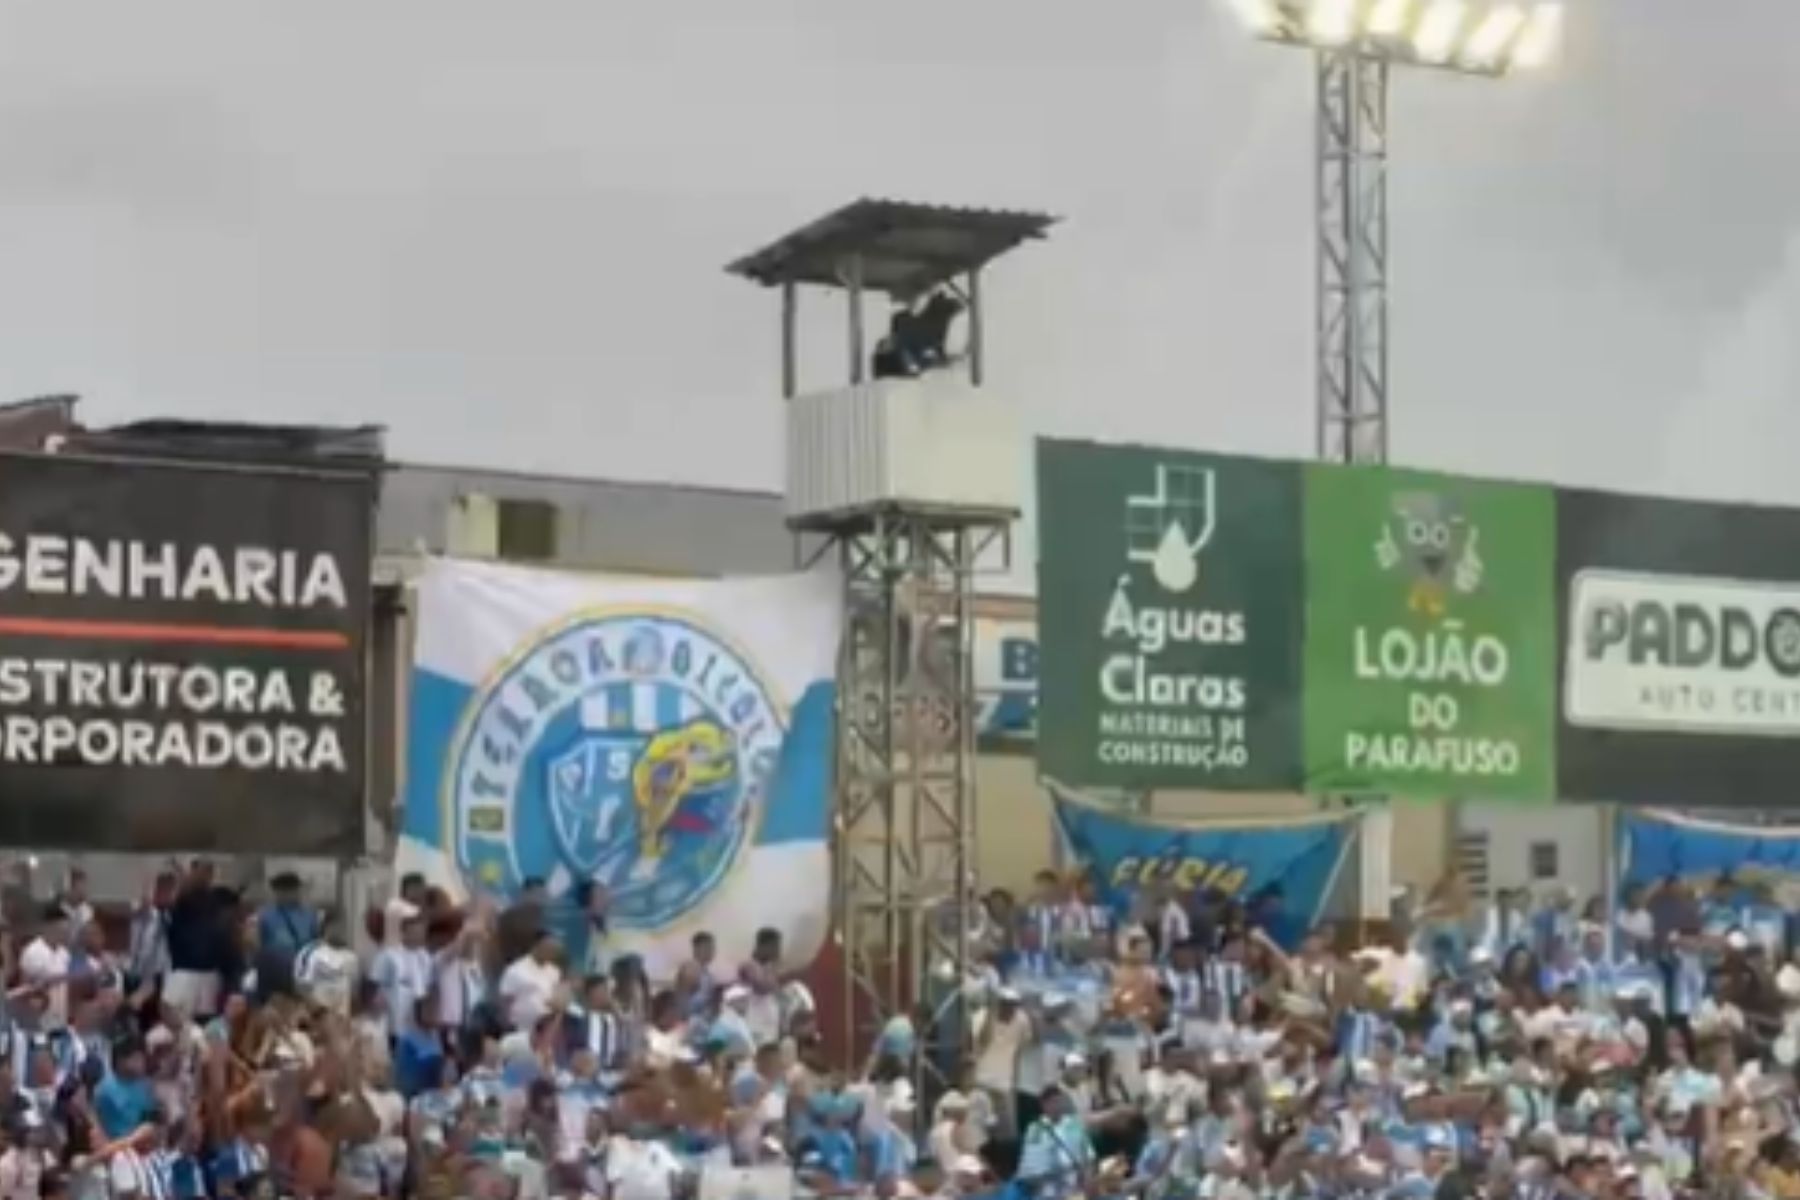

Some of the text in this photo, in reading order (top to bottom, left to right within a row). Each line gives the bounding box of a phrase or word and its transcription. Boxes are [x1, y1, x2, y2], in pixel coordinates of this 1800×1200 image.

[1103, 575, 1245, 651] Águas
[1356, 619, 1508, 683] LOJÃO
[0, 658, 344, 715] STRUTORA &
[1101, 656, 1245, 709] Claros
[1100, 713, 1244, 741] MATERIAIS DE
[1409, 694, 1458, 729] DO
[0, 716, 346, 770] RPORADORA
[1099, 741, 1247, 770] CONSTRUÇÃO
[1346, 733, 1520, 774] PARAFUSO
